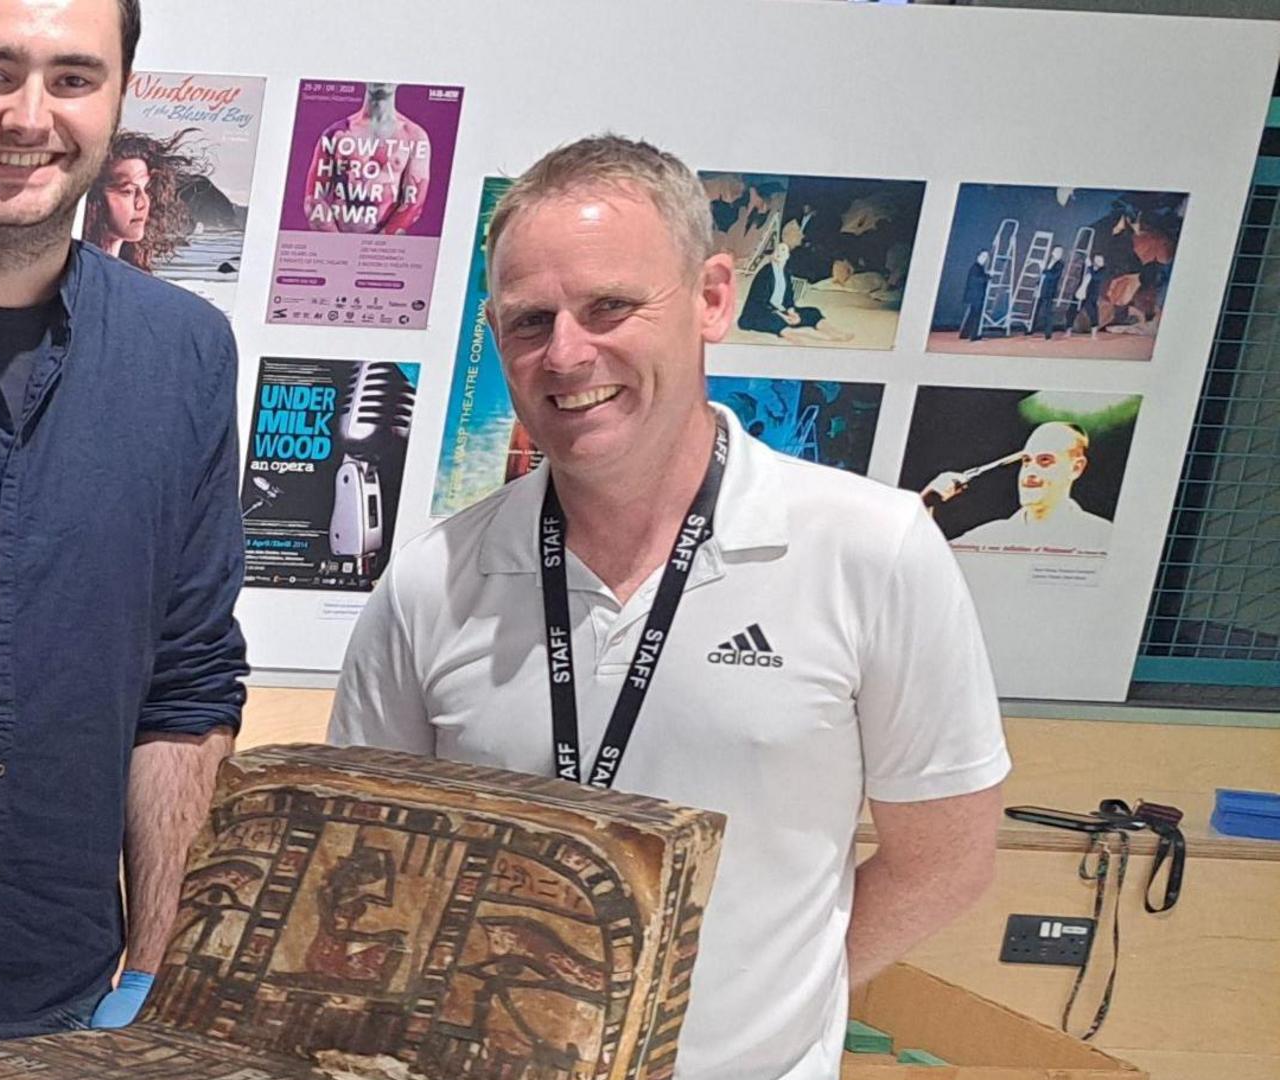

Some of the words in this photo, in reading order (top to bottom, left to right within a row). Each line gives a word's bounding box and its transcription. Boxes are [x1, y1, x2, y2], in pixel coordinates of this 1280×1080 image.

[222, 107, 254, 128] Bay
[321, 136, 380, 157] NOW
[386, 139, 429, 160] THE
[317, 159, 381, 180] HERO
[314, 182, 384, 203] NAWR
[390, 185, 418, 204] YR
[310, 204, 379, 225] ARWR
[260, 385, 337, 411] UNDER
[460, 366, 478, 424] THEATRE
[257, 410, 334, 435] MILK
[255, 435, 331, 460] WOOD
[715, 427, 727, 465] AFF
[251, 460, 269, 471] an
[271, 461, 315, 474] opera
[544, 516, 561, 569] STAFF
[671, 514, 706, 572] STAFF
[550, 626, 570, 684] STAFF
[629, 628, 664, 690] STAFF
[707, 648, 783, 668] adidas
[558, 742, 577, 779] AFF
[592, 746, 620, 788] STA
